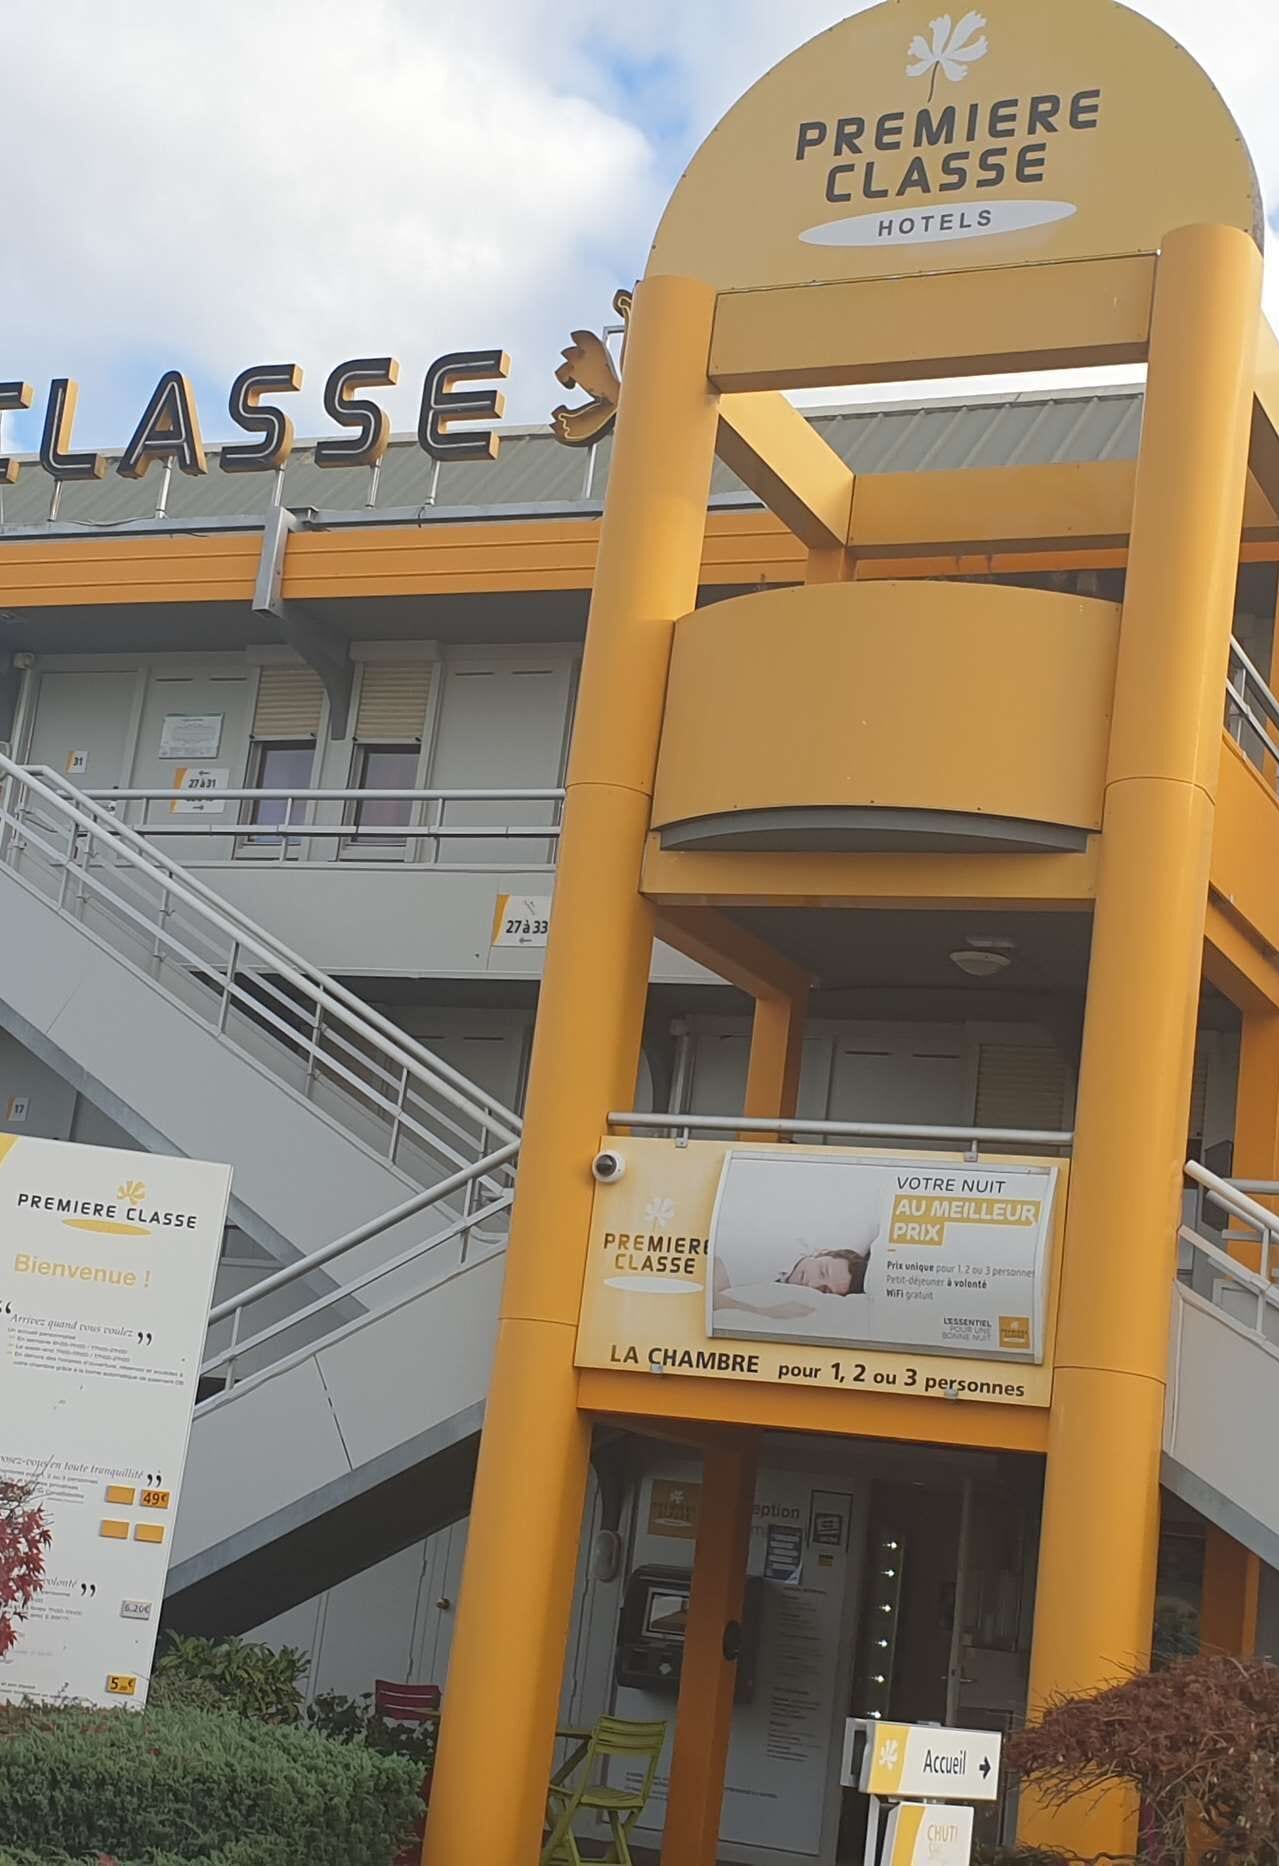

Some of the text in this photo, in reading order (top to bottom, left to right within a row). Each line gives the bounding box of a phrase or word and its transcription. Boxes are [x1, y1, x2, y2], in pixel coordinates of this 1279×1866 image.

[796, 89, 1100, 160] PREMIERE
[825, 142, 1047, 203] CLASSE
[877, 209, 992, 237] HOTELS
[73, 757, 83, 766] 31
[188, 779, 200, 788] 27
[206, 779, 216, 788] 31
[506, 919, 548, 934] 27 à 33
[896, 1176, 1006, 1194] VOTRE NUIT
[17, 1193, 197, 1229] PREMIERE CLASSE
[895, 1199, 1036, 1222] AU MEILLEUR
[893, 1223, 941, 1241] PRIX
[14, 1253, 151, 1288] Bienvenue !
[615, 1253, 696, 1275] CLASSE
[886, 1261, 903, 1270] Prix
[905, 1263, 934, 1273] unique
[936, 1265, 955, 1274] pour
[965, 1265, 971, 1273] 2
[972, 1267, 983, 1275] ou
[985, 1266, 991, 1275] 3
[886, 1274, 987, 1289] Petit-déjeuner à volonté
[905, 1291, 933, 1301] gratuit
[10, 1313, 134, 1338] Arrivez quand vous voulez
[610, 1344, 1026, 1397] LA CHAMBRE pour 1, 2 ou 3 personnes
[64, 1461, 88, 1474] toute
[89, 1464, 145, 1480] tranquillité
[923, 1748, 967, 1775] Accueil
